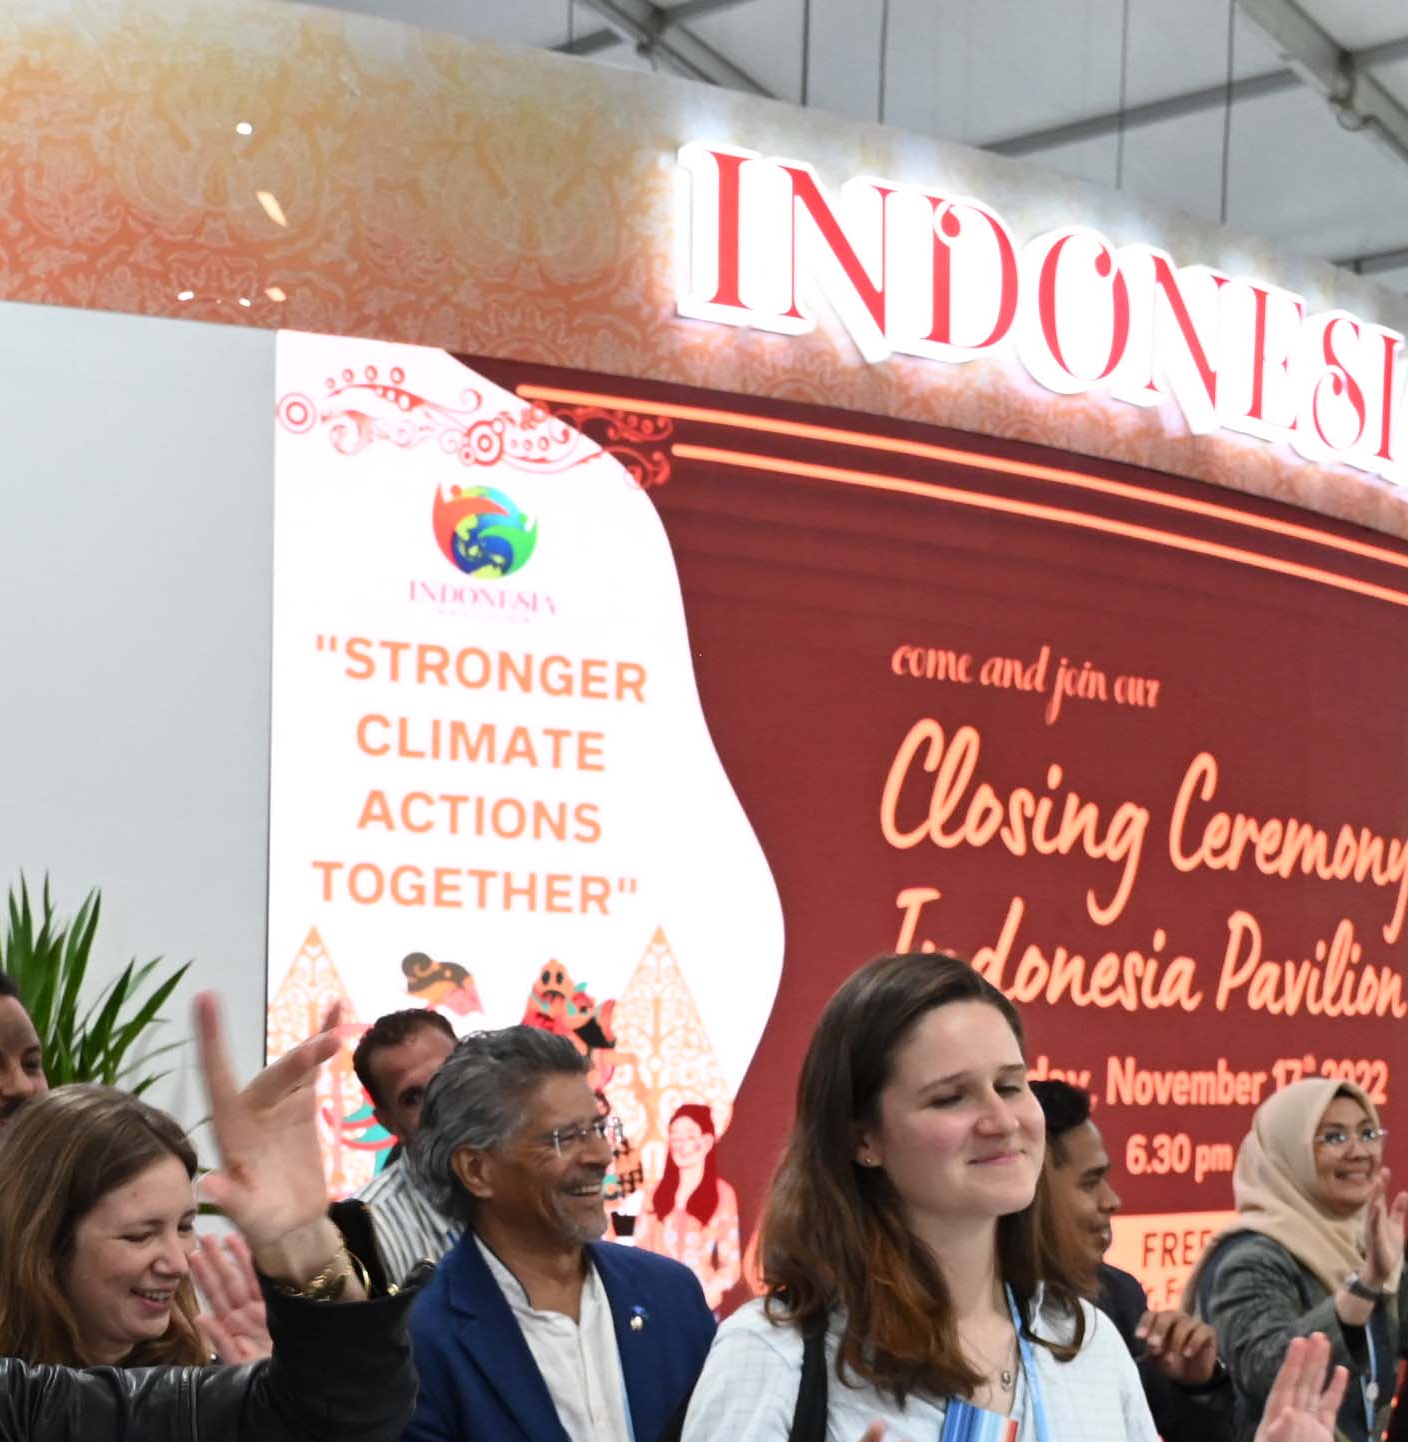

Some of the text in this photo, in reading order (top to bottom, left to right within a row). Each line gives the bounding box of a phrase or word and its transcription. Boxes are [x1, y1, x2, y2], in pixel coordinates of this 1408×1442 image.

[315, 633, 647, 703] "STRONGER
[891, 643, 1161, 725] come and join our
[355, 713, 606, 771] CLIMATE
[356, 788, 602, 844] ACTIONS
[879, 717, 1150, 926] Closing
[311, 859, 639, 917] TOGETHER"
[894, 887, 1408, 1020] Idonesia Pavilion
[1106, 1055, 1268, 1106] November
[1125, 1132, 1234, 1183] 6.30 pm
